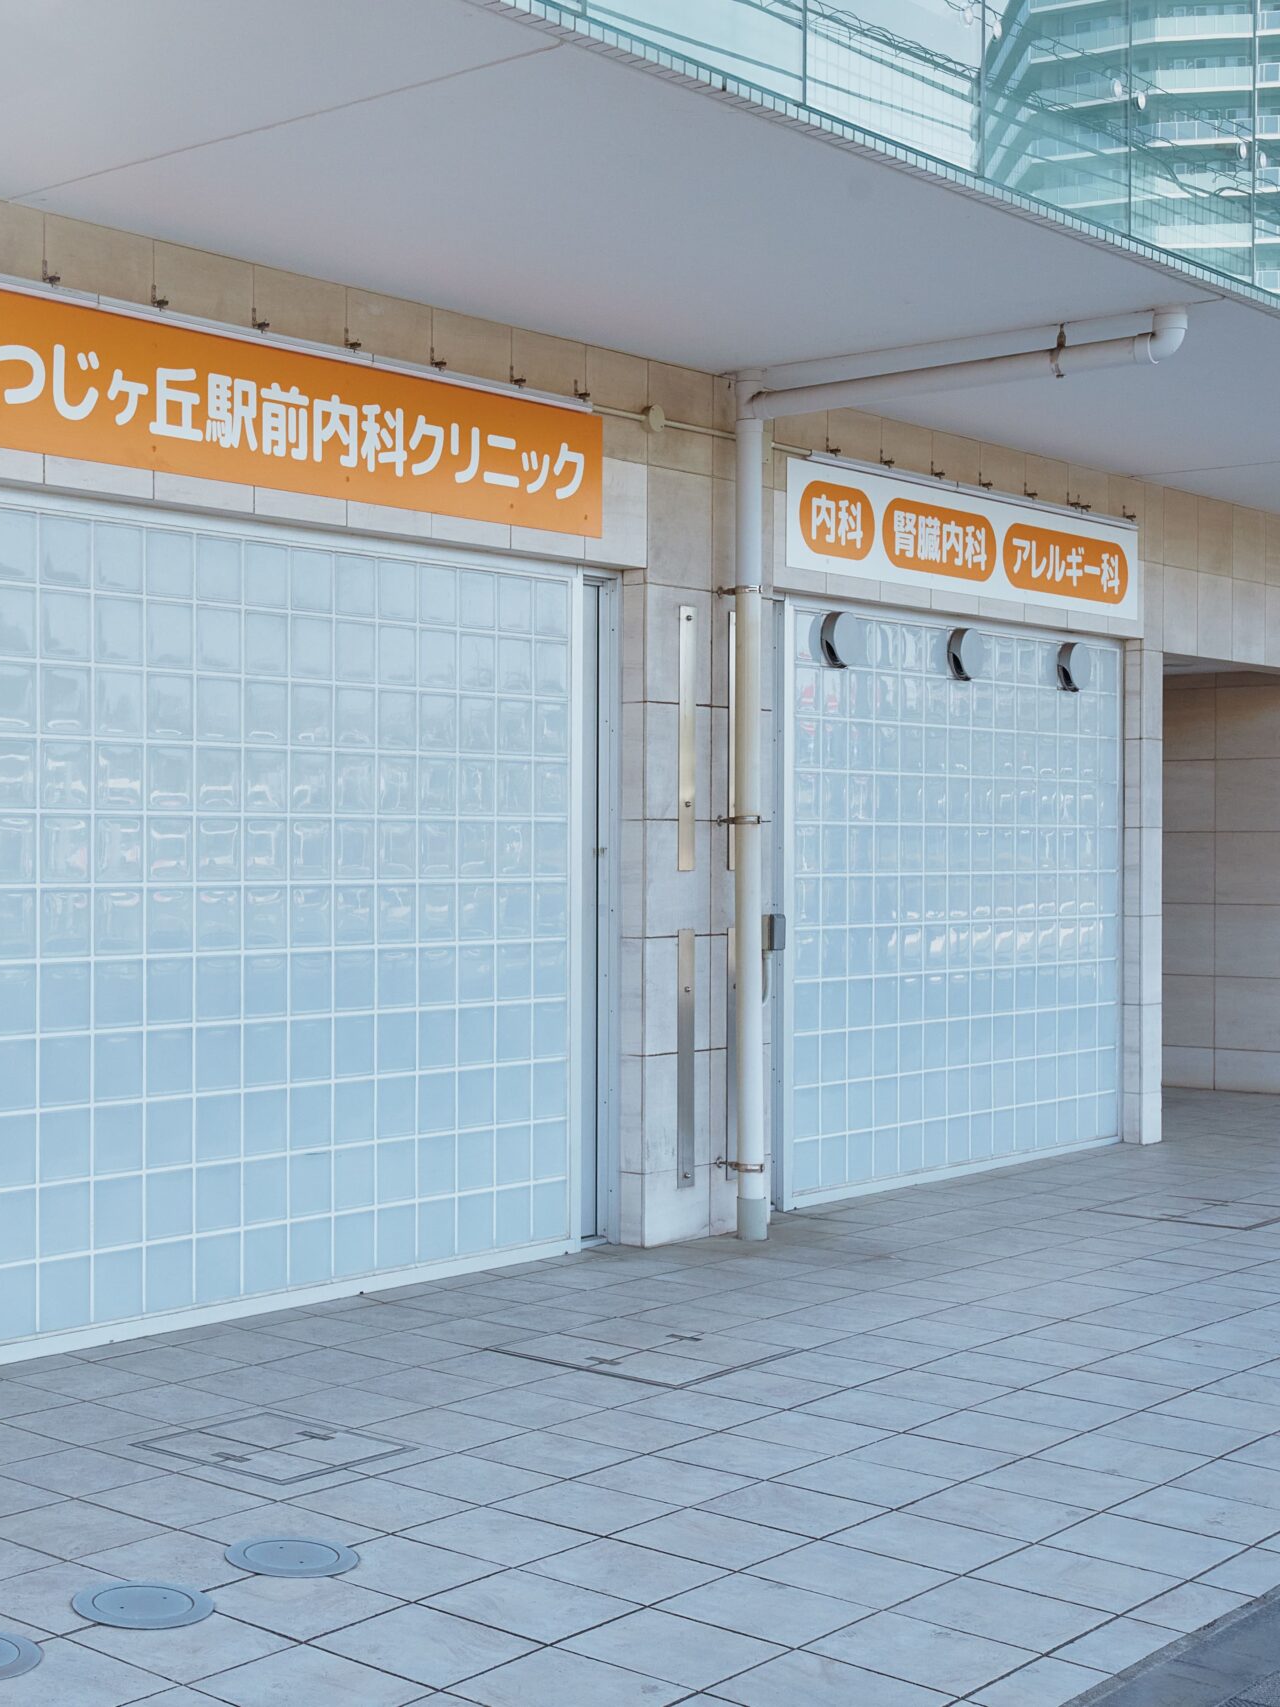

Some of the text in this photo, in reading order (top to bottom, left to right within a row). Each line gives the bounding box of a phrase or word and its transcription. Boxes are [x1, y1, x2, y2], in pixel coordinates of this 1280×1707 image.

[811, 494, 864, 549] 内科
[893, 510, 988, 571] 腎臓内科
[1012, 538, 1120, 595] アレルギー科
